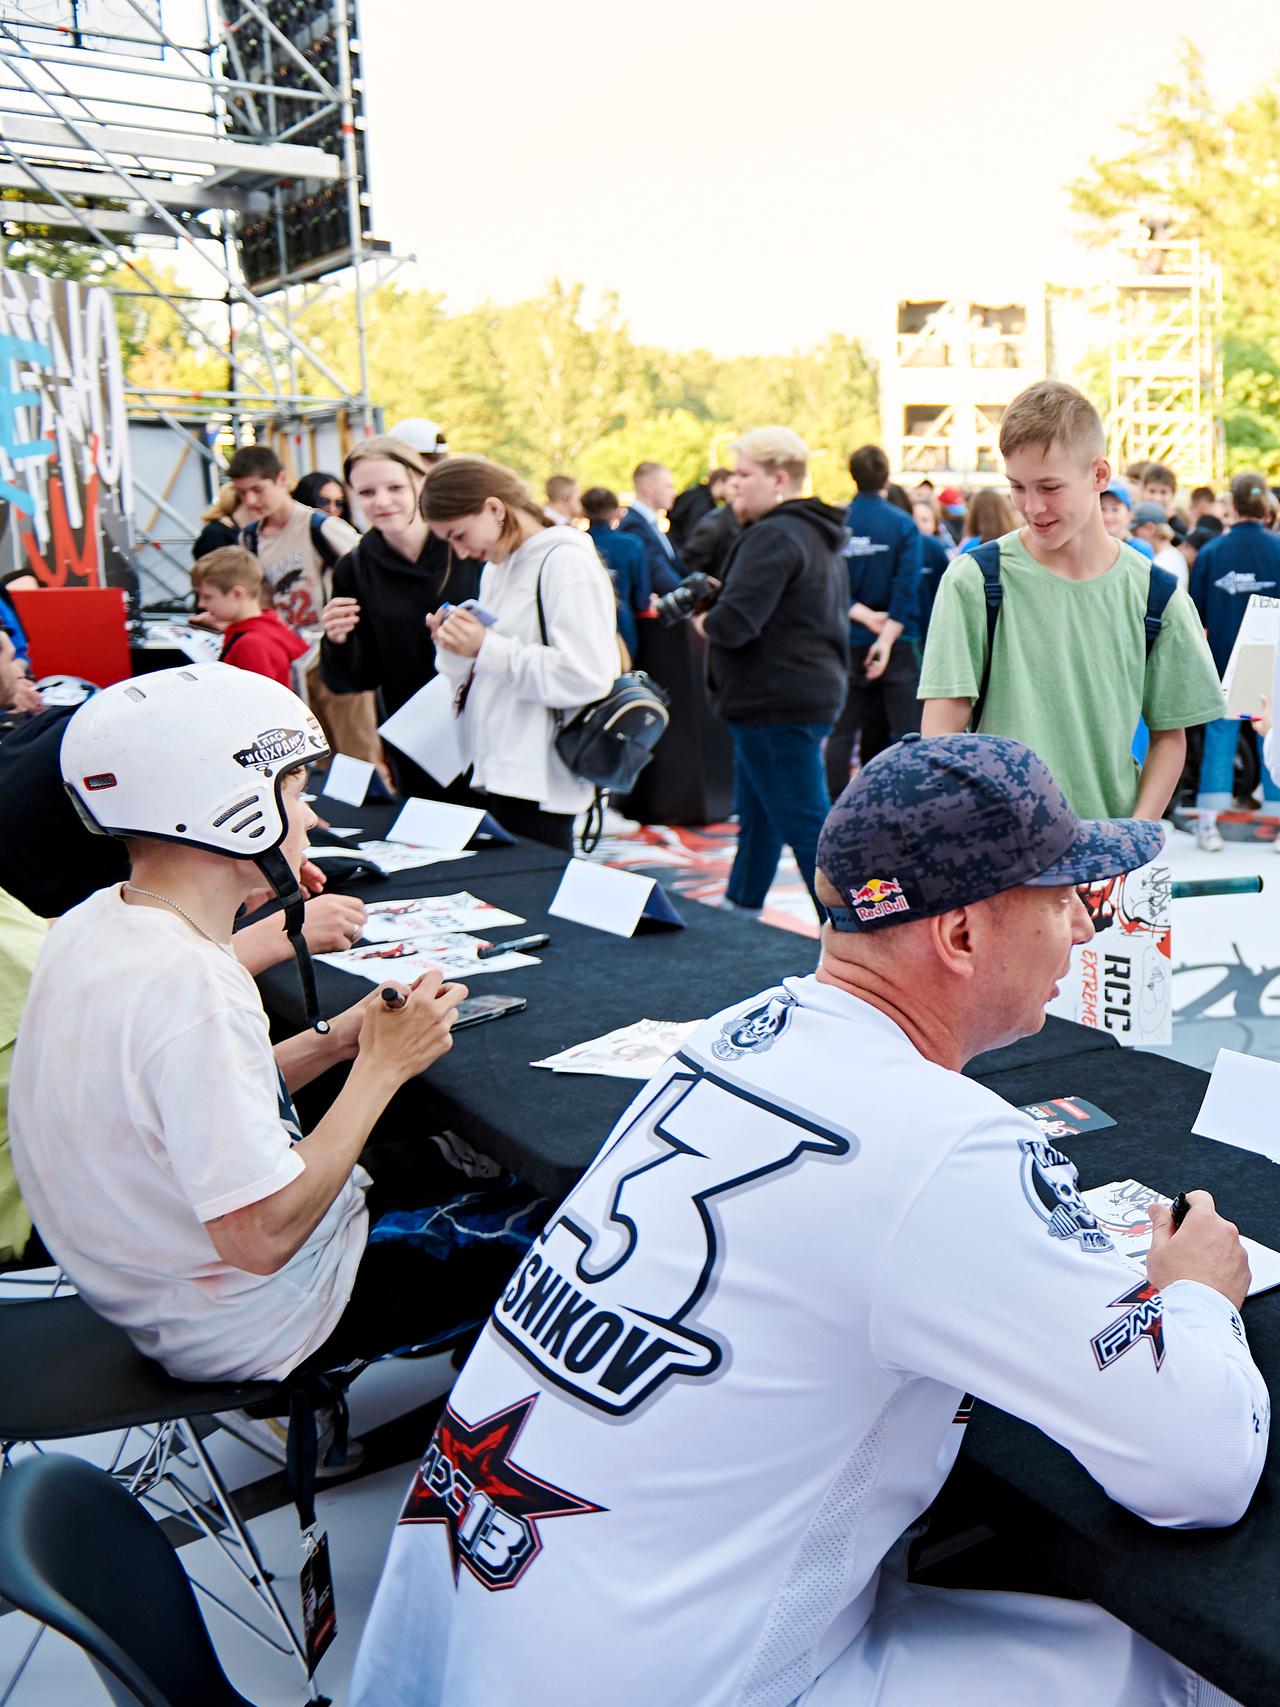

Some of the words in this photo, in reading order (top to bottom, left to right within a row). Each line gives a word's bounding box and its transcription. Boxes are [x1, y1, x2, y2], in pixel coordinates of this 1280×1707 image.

[856, 902, 885, 921] Red
[881, 894, 910, 914] Bull
[1079, 949, 1099, 1028] EXTREME
[1104, 953, 1131, 1032] RCC
[500, 1252, 699, 1396] SNIKOV
[459, 1490, 532, 1578] 13
